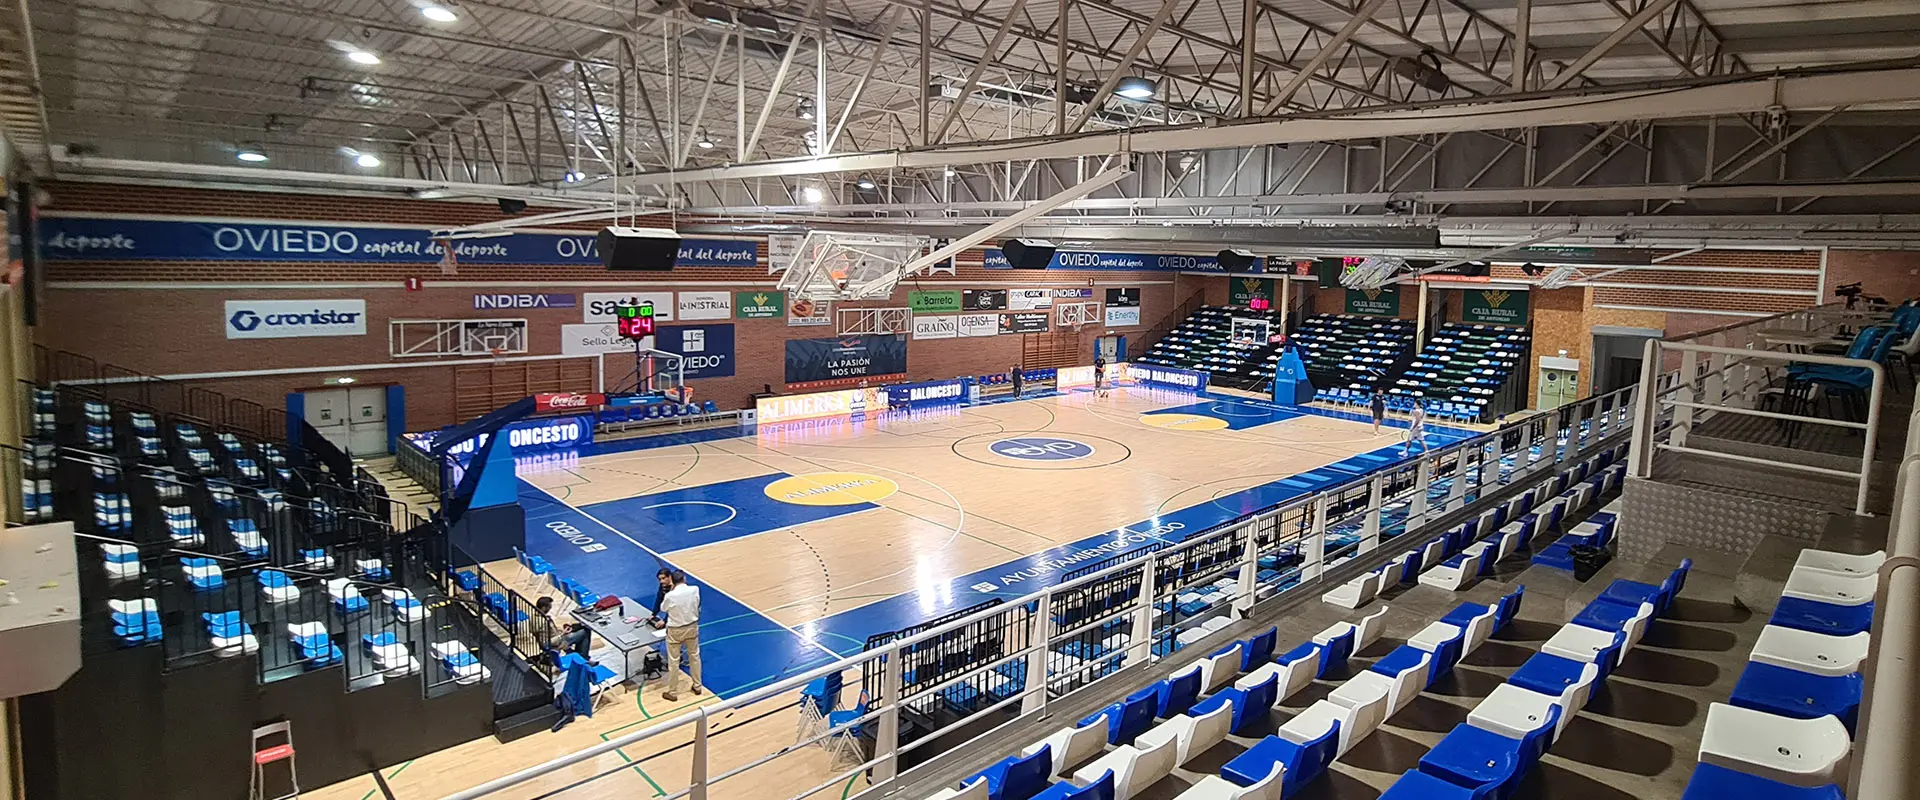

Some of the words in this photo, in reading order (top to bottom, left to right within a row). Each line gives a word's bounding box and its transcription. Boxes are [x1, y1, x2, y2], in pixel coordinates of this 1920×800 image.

[213, 227, 359, 254] OVIEDO
[363, 240, 421, 258] capital
[454, 242, 508, 258] deporte
[696, 249, 713, 260] del
[715, 250, 753, 262] deporte
[1059, 252, 1101, 267] OVIEDO
[1157, 256, 1197, 269] OVIEDO
[411, 278, 417, 289] 1
[1053, 289, 1082, 298] INDIBA
[474, 294, 549, 308] INDIBA
[924, 296, 953, 305] Barreto
[264, 309, 360, 326] cronistar
[1471, 307, 1490, 316] CAJA
[1491, 309, 1518, 317] RURAL
[631, 318, 652, 335] 24
[582, 337, 608, 347] Sello
[827, 360, 839, 369] LA
[840, 357, 871, 367] PASIÓN
[831, 368, 849, 377] NOS
[850, 366, 867, 375] UNE
[1126, 366, 1151, 380] OVIEDO
[1152, 369, 1199, 387] BALONCESTO
[910, 384, 962, 400] BALONCESTO
[1000, 539, 1129, 586] AYUNTAMIENTO
[1128, 522, 1186, 543] OVIEDO
